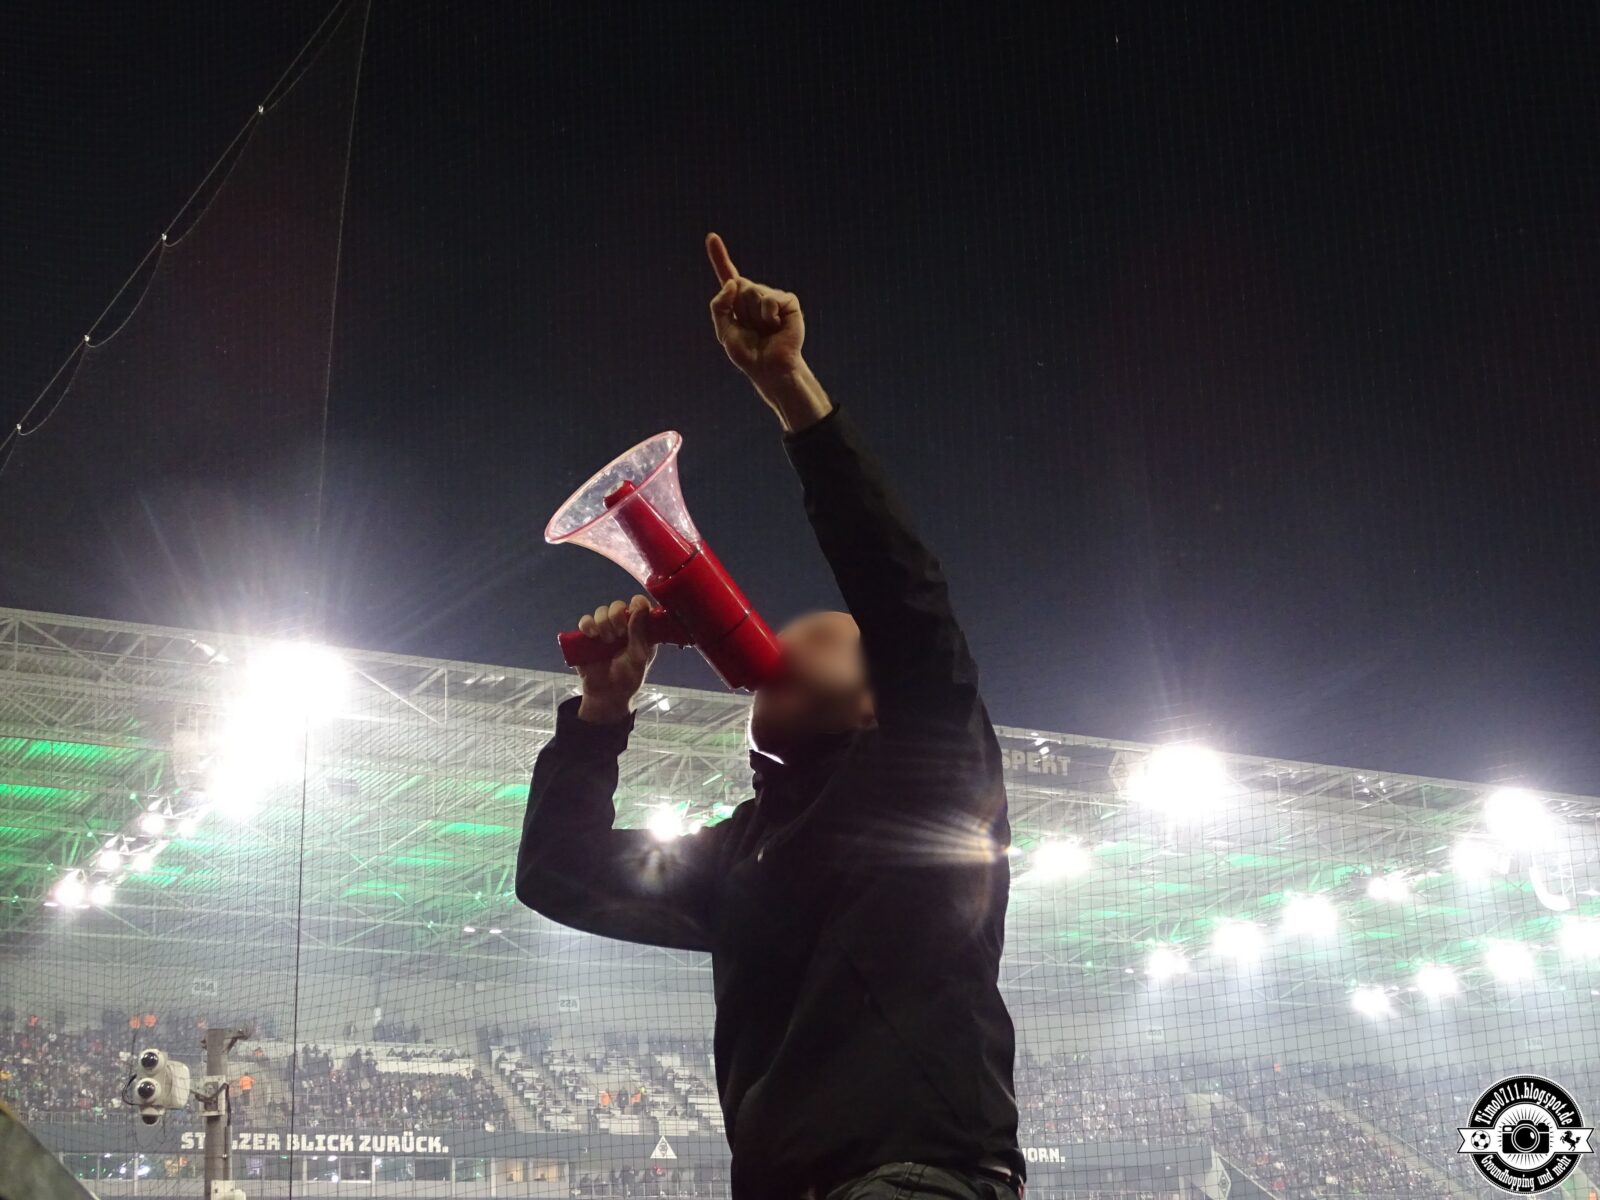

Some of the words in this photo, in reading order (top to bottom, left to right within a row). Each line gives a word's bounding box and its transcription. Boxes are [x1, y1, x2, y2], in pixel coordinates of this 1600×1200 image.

[181, 1132, 281, 1151] STZER
[286, 1133, 354, 1152] BLICK
[359, 1131, 449, 1153] ZURÜCK.
